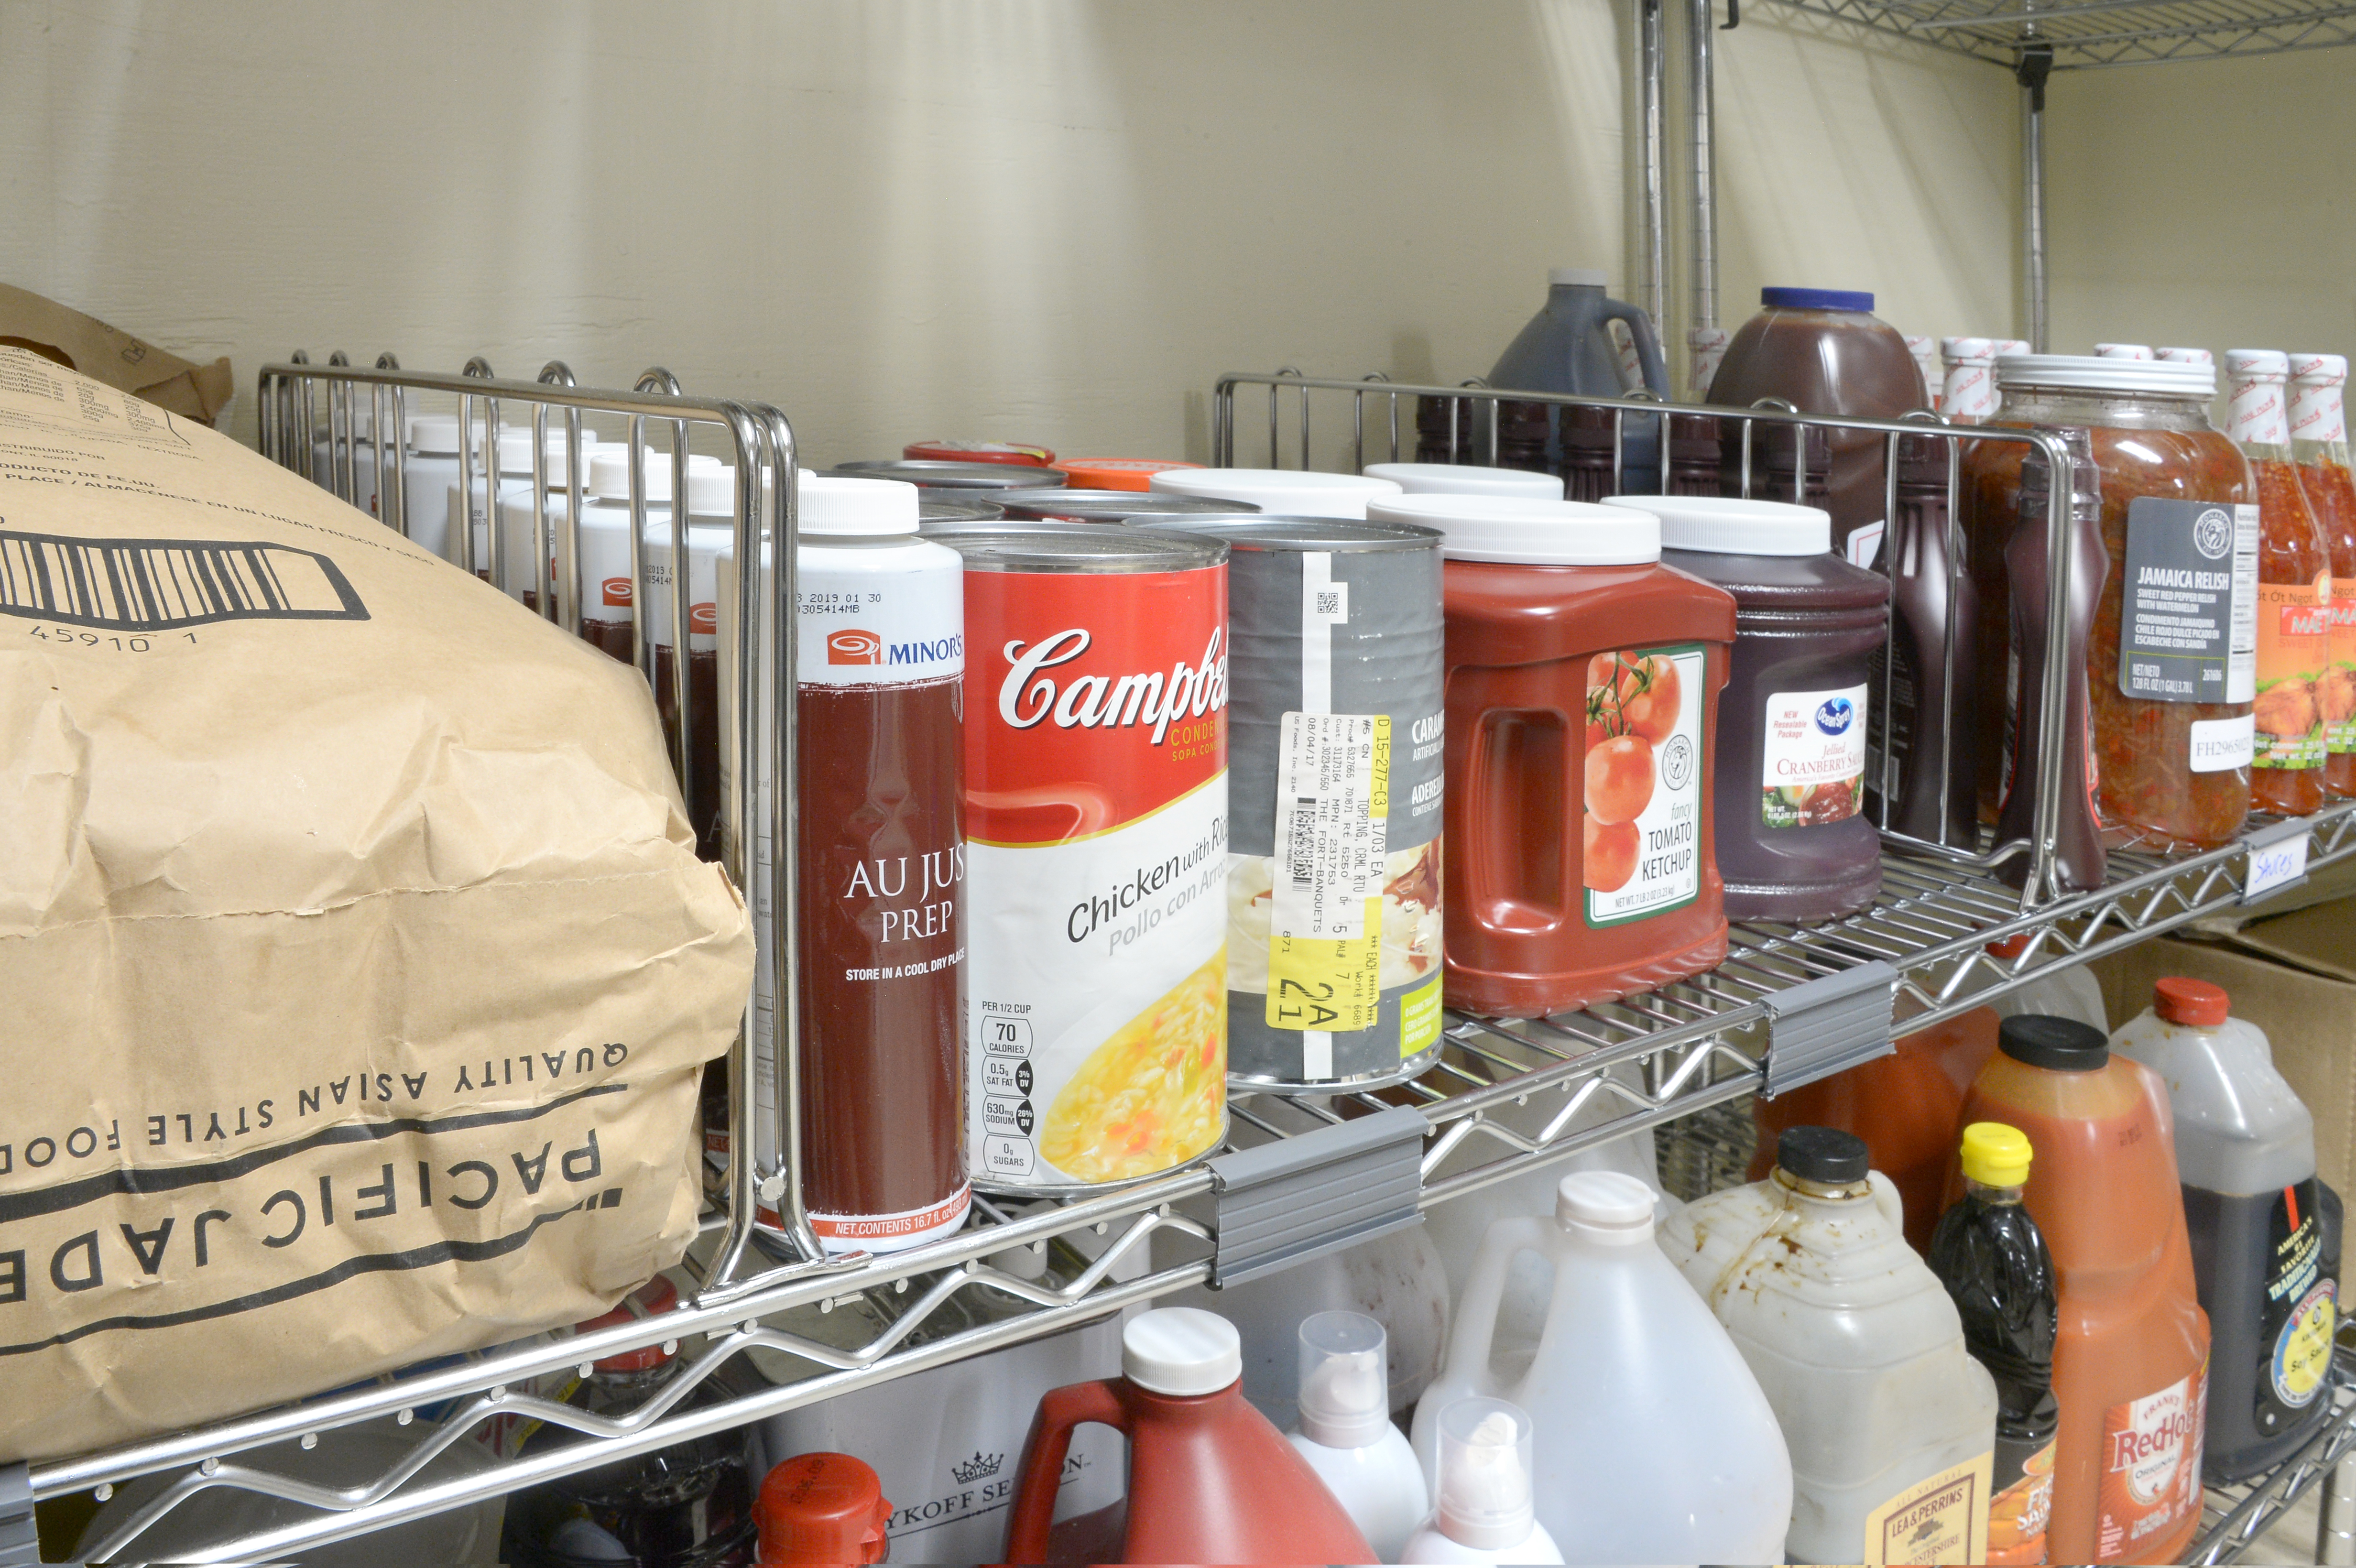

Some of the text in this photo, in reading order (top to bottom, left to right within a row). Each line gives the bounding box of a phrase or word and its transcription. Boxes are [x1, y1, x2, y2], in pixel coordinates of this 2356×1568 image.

[5, 473, 65, 485] PLACE
[233, 506, 257, 515] UN
[261, 512, 315, 530] LUGAR
[319, 527, 378, 547] FRESCO
[2138, 566, 2230, 590] JAMAICA RELISH
[810, 594, 838, 603] 2019
[845, 594, 858, 602] 01
[868, 594, 881, 602] 30
[2137, 588, 2160, 599] SWEET
[2160, 589, 2174, 600] RED
[2175, 590, 2197, 602] PEPPER
[2137, 599, 2199, 613] WITH WATERMELON
[2136, 613, 2180, 626] CONDIMENTO
[30, 625, 198, 653] 45910 1
[2136, 624, 2192, 638] CHILE ROJO DULCE
[888, 632, 962, 665] MINOR'S
[2135, 634, 2185, 648] ESCABECHE CON
[2144, 678, 2150, 690] FL
[2151, 679, 2158, 691] OZ
[1294, 716, 1299, 725] US
[1378, 719, 1390, 727] D
[1784, 710, 1799, 719] NEW
[1773, 720, 1807, 729] Resealable
[1306, 718, 1316, 766] 08/04/17
[1778, 730, 1803, 740] Package
[1173, 747, 1196, 762] SOPA
[1822, 741, 1846, 759] Jellied
[1332, 746, 1342, 783] 31173164
[1777, 757, 1846, 775] CRANBERRY
[1319, 799, 1328, 822] THE
[1331, 799, 1340, 828] MPN:
[1671, 803, 1692, 821] fancy
[1343, 823, 1351, 838] Rt
[1372, 823, 1385, 853] 1/03
[1649, 821, 1691, 852] TOMATO
[1328, 838, 1338, 885] 231753
[1341, 847, 1350, 878] 5250
[1371, 861, 1383, 877] EA
[1643, 849, 1691, 882] KETCHUP
[843, 858, 907, 898] AU
[1353, 719, 1371, 1025] #5 CN TOPPING, CRML RTU 6689
[1068, 856, 1179, 943] Chicken
[1183, 836, 1210, 871] with
[1313, 830, 1326, 933] FORT-BANQUETS
[1109, 858, 1225, 957] Pollo con Arroz
[1340, 896, 1348, 905] Dr
[1615, 897, 1625, 908] NET
[1625, 895, 1635, 906] WT.
[1636, 894, 1639, 904] 7
[1640, 893, 1646, 903] LB
[1647, 892, 1650, 901] 2
[1650, 889, 1656, 900] OZ
[880, 900, 953, 943] PREP
[1282, 930, 1291, 953] 871
[1335, 940, 1346, 958] PAL#
[846, 947, 965, 981] STORE IN A COOL DRY PLACE
[1366, 952, 1377, 970] EACH
[982, 1001, 1031, 1014] PER 1/2 CUP
[996, 1023, 1016, 1042] 70
[1405, 1019, 1417, 1032] CERO
[1405, 1033, 1415, 1045] POR
[989, 1043, 1024, 1054] CALORIES
[453, 1042, 629, 1094] QUALITY
[991, 1063, 1009, 1077] 0.5g
[1018, 1070, 1030, 1078] 3%
[987, 1076, 1013, 1087] SAT FAT
[1020, 1079, 1029, 1088] DV
[298, 1070, 429, 1116] ASIAN
[987, 1102, 1014, 1117] 630mg
[1017, 1109, 1033, 1118] 26%
[148, 1098, 274, 1147] STYLE
[986, 1114, 1015, 1126] SODIUM
[1021, 1118, 1030, 1127] DV
[1003, 1143, 1013, 1156] 0g
[994, 1155, 1024, 1167] SUGARS
[262, 1127, 602, 1251] PACIFIC
[835, 1222, 856, 1235] NET
[859, 1220, 911, 1235] CONTENTS
[914, 1213, 931, 1229] 16.7
[942, 1209, 949, 1220] oz
[2277, 1215, 2312, 1256] AMERICA'S
[2280, 1234, 2315, 1274] FAVORITE
[2291, 1357, 2307, 1372] Soy
[2135, 1454, 2176, 1479] ORIGINAL
[1918, 1470, 1962, 1495] NATURAL
[1892, 1488, 1963, 1537] LEA & PERRINS
